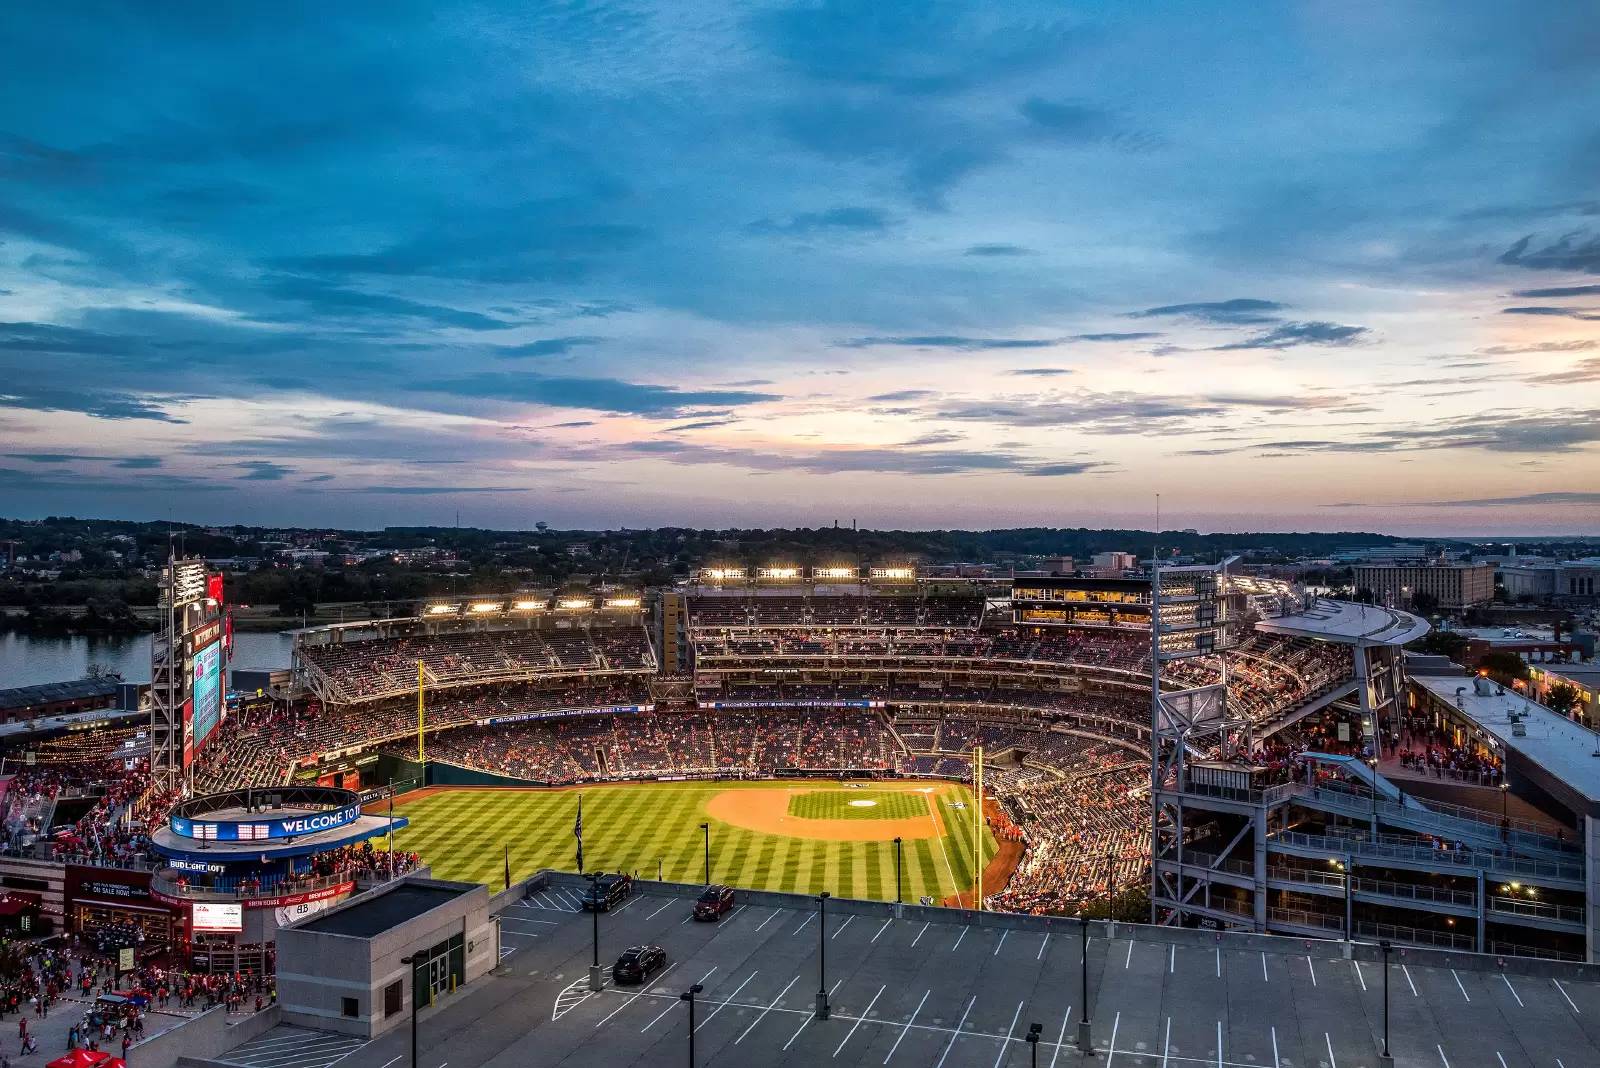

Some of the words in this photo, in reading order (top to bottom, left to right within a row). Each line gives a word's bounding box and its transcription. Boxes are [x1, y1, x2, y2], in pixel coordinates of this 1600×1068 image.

[363, 792, 378, 801] DELTA
[282, 811, 342, 833] WELCOME
[345, 808, 354, 821] TO
[170, 860, 184, 869] BUD
[207, 864, 225, 873] LOFT
[102, 887, 115, 895] SALE
[116, 889, 130, 897] NOW!
[308, 891, 321, 900] BREW
[321, 889, 335, 897] HOUSE
